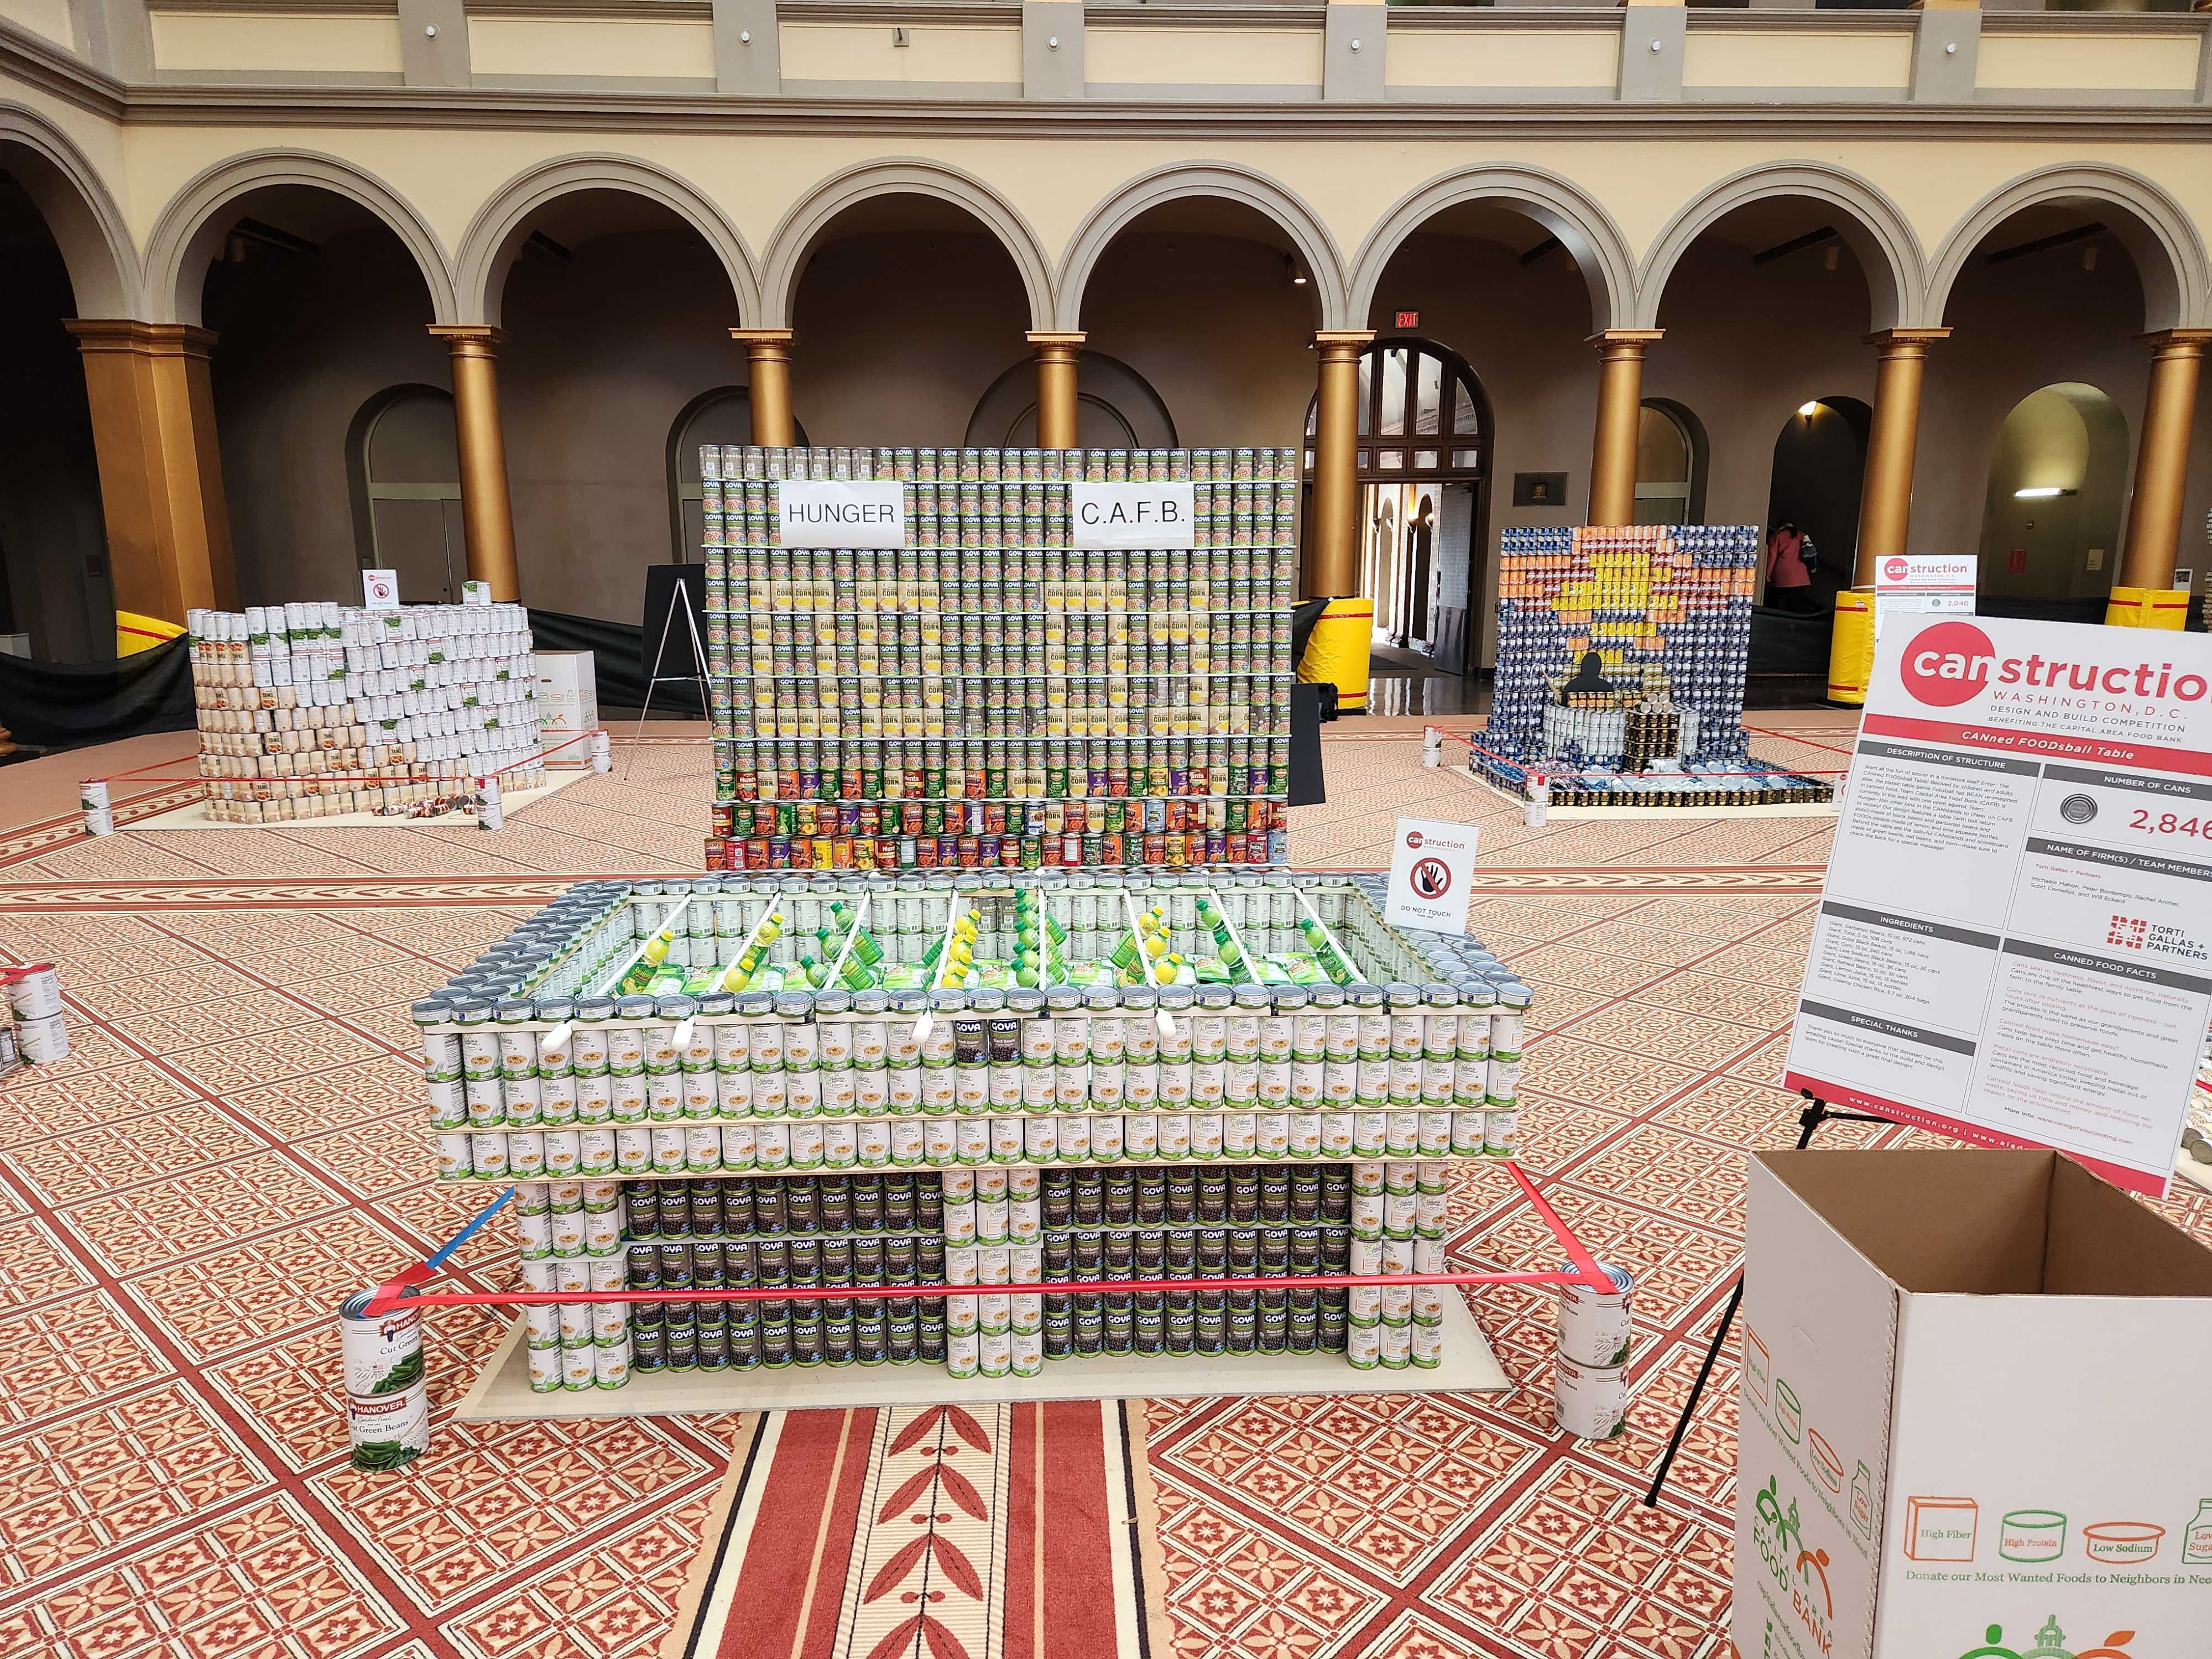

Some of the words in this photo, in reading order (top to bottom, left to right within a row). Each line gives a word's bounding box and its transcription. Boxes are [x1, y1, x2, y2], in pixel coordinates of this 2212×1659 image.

[1398, 313, 1417, 327] EXIT
[789, 503, 894, 523] HUNGER
[1081, 501, 1185, 524] C.A.F.B.
[1887, 564, 1967, 573] canstruction
[1914, 650, 2212, 702] canstructio
[1988, 716, 2042, 728] BENEFITING
[2060, 724, 2096, 733] CAPITAL
[1991, 705, 2031, 716] DESIGN
[2035, 710, 2058, 718] AND
[2064, 712, 2097, 722] BUILD
[2103, 717, 2185, 732] COMPETITION
[1961, 731, 2011, 745] CANned
[2017, 737, 2091, 754] FOODsball
[2097, 747, 2134, 759] Table
[1886, 747, 1940, 760] DESCRIPTION
[1955, 756, 2006, 769] STRUCTURE
[2104, 776, 2145, 787] NUMBER
[2163, 784, 2191, 794] CANS
[1408, 837, 1464, 849] canstruction
[2047, 844, 2073, 855] NAME
[2092, 852, 2128, 864] FIRM(S)
[2138, 859, 2165, 869] TEAM
[2075, 870, 2101, 879] Partners
[2032, 877, 2057, 885] Michaela
[2100, 888, 2132, 899] Bontempo,
[2048, 886, 2076, 896] Cornelius,
[1880, 916, 1934, 932] INGREDIENTS
[2152, 925, 2184, 937] TORTI
[2149, 934, 2194, 948] GALLAS
[2147, 942, 2208, 960] PARTNERS
[2053, 952, 2093, 966] CANNED
[2095, 961, 2124, 973] FOOD
[2126, 967, 2157, 979] FACTS
[2072, 981, 2104, 992] healthiest
[956, 1023, 980, 1032] GOYA
[992, 1022, 1016, 1031] GOYA
[1850, 1015, 1884, 1029] SPECIAL
[1886, 1024, 1918, 1038] THANKS
[1849, 1095, 1959, 1134] www.canstruction.org
[2004, 1106, 2020, 1115] More
[2021, 1110, 2036, 1119] Info:
[2037, 1115, 2133, 1146] www.cansgetyoucooking.com
[1048, 1188, 1070, 1198] GOYA
[1078, 1186, 1101, 1195] GOYA
[1110, 1185, 1133, 1194] GOYA
[1143, 1185, 1165, 1194] GOYA
[632, 1196, 656, 1207] GOYA
[661, 1196, 686, 1206] GOYA
[693, 1196, 717, 1206] GOYA
[727, 1196, 752, 1206] GOYA
[1198, 1315, 1221, 1324] GOYA
[699, 1329, 723, 1339] GOYA
[398, 1337, 418, 1349] Green
[357, 1400, 403, 1413] HANOVER
[359, 1425, 382, 1433] Green
[385, 1421, 409, 1431] Beans
[1921, 1529, 1944, 1540] High
[1947, 1530, 1971, 1540] Fiber
[2005, 1538, 2025, 1548] High
[2027, 1539, 2057, 1547] Protein
[2093, 1544, 2114, 1552] Low
[2116, 1544, 2152, 1552] Sodium
[2189, 1542, 2212, 1552] Suga
[1754, 1515, 1797, 1586] CAPITAL
[1804, 1594, 1832, 1642] AREA
[1906, 1571, 1948, 1582] Donate
[1951, 1573, 1971, 1582] our
[1974, 1572, 2004, 1582] Most
[2008, 1573, 2053, 1583] Wanted
[2057, 1573, 2091, 1583] Foods
[2095, 1575, 2106, 1584] to
[2110, 1574, 2170, 1586] Neighbors
[2173, 1575, 2185, 1584] in
[2188, 1575, 2212, 1585] Nee
[1754, 1525, 1787, 1592] FOOD
[1793, 1589, 1832, 1659] BANK
